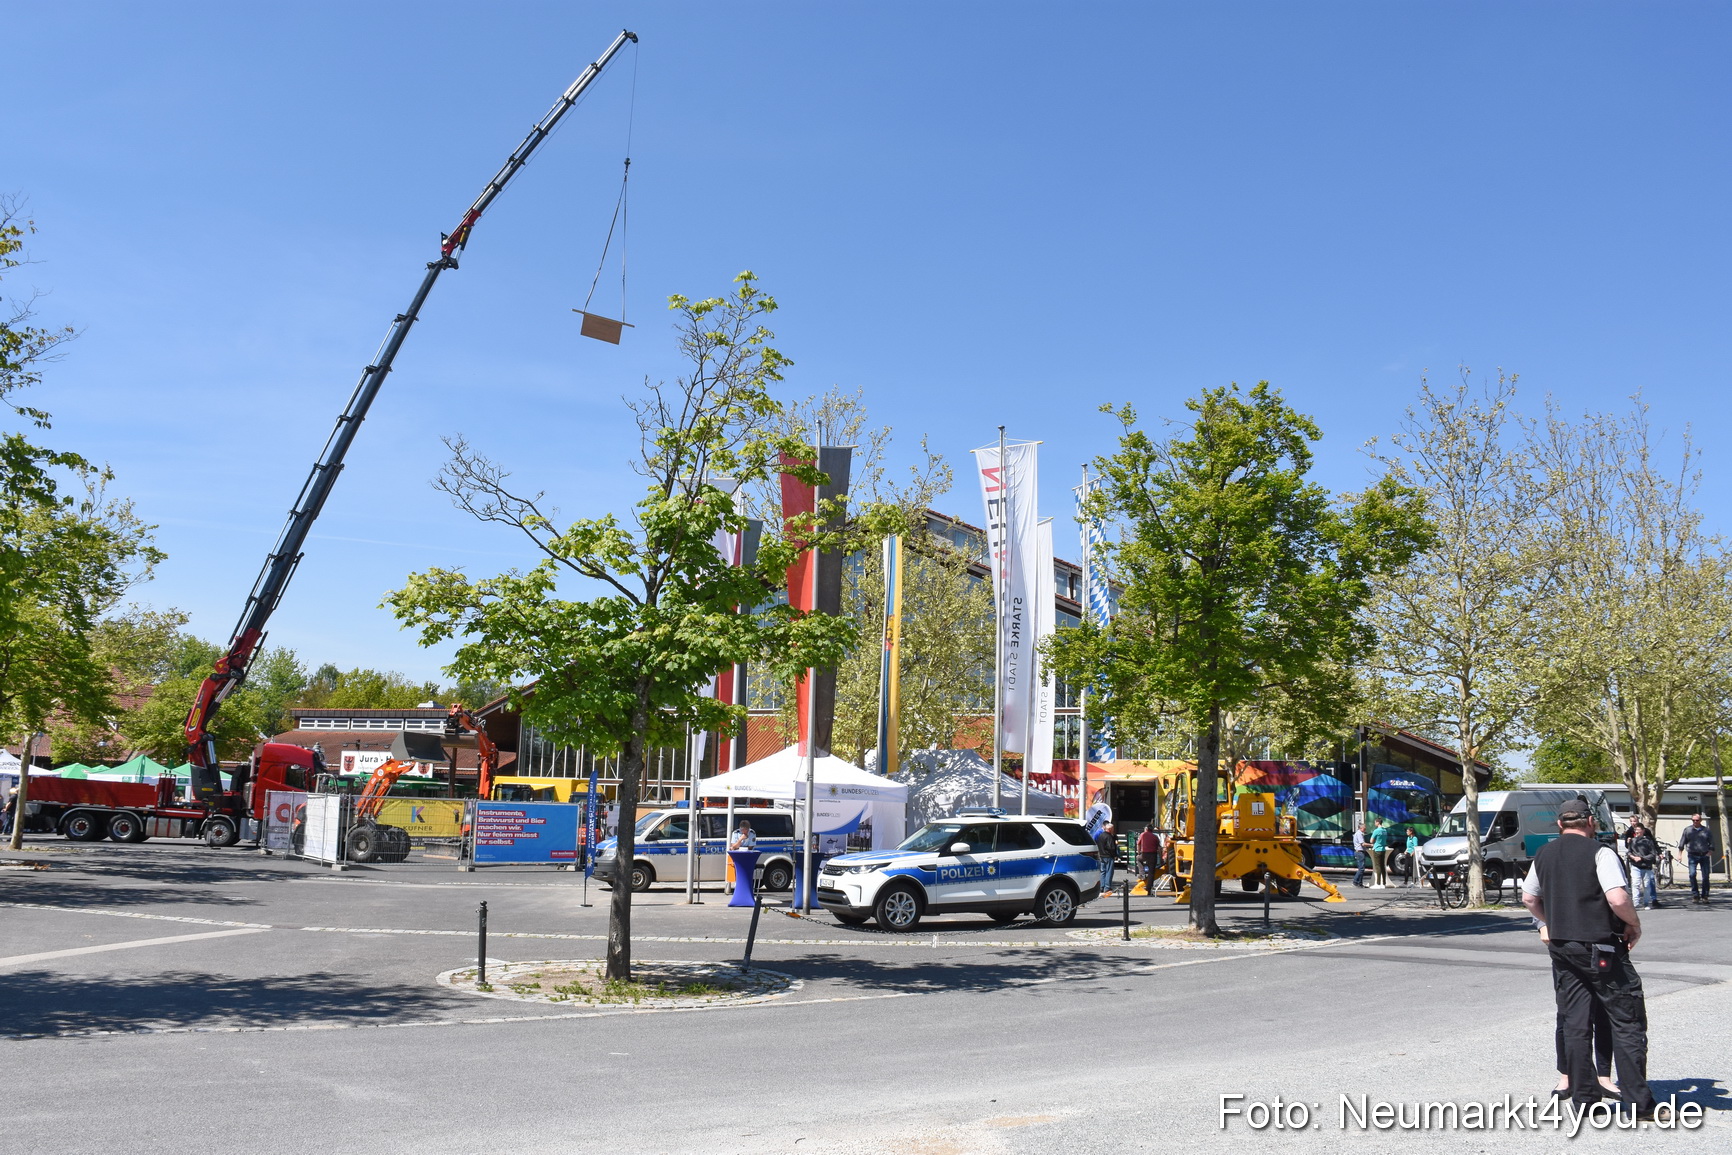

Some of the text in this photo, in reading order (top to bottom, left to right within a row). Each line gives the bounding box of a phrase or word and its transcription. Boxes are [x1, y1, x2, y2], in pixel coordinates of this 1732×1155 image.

[359, 754, 379, 762] Jura
[841, 788, 880, 796] BUNDESPOLIZEI
[940, 865, 984, 880] POLIZEI
